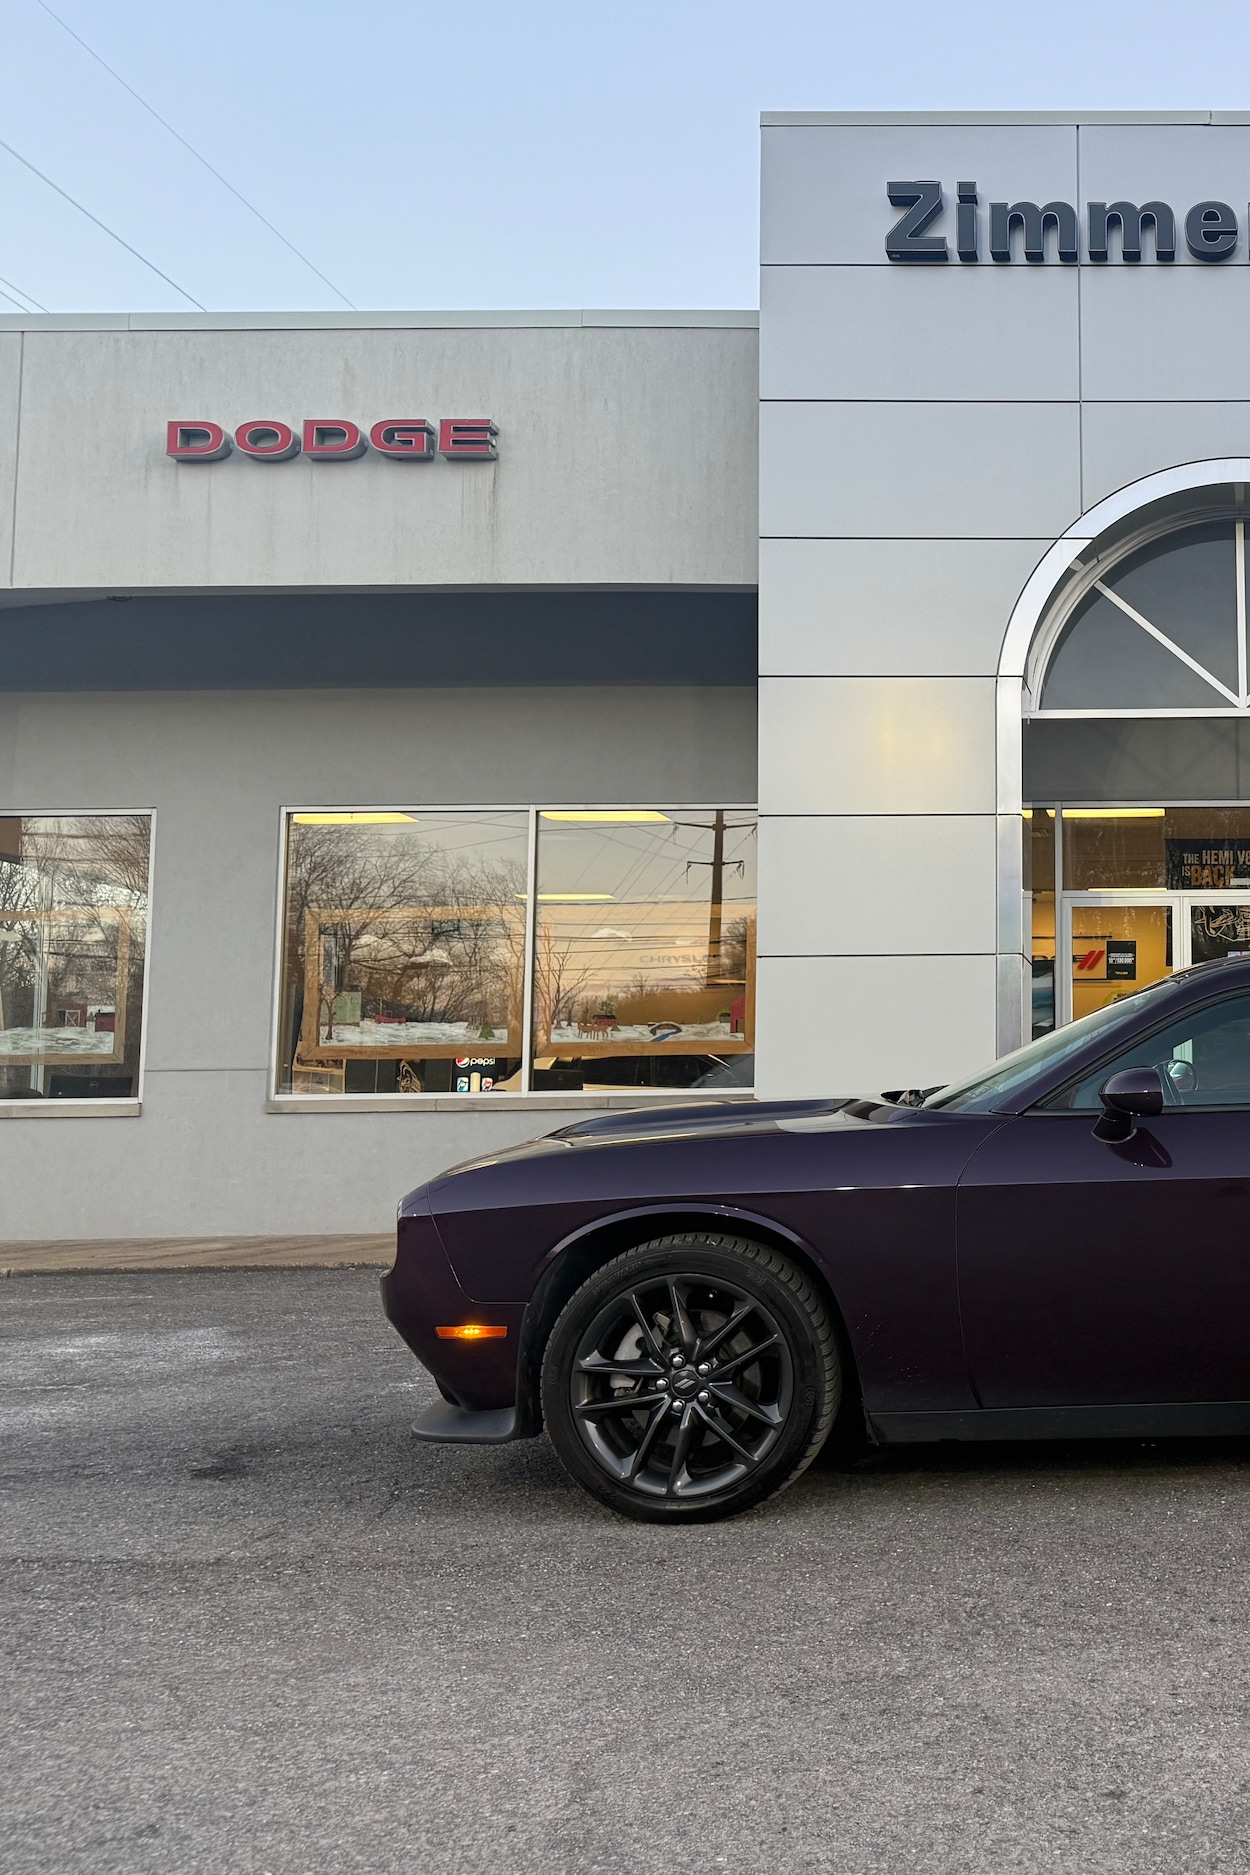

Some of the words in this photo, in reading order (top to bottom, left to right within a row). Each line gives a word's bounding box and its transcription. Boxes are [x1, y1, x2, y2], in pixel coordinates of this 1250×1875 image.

[166, 419, 499, 462] DODGE
[1183, 853, 1200, 864] THE
[1202, 850, 1234, 865] HEMI
[1182, 866, 1191, 877] IS
[1191, 865, 1236, 886] BACK
[470, 1057, 496, 1067] pepsi
